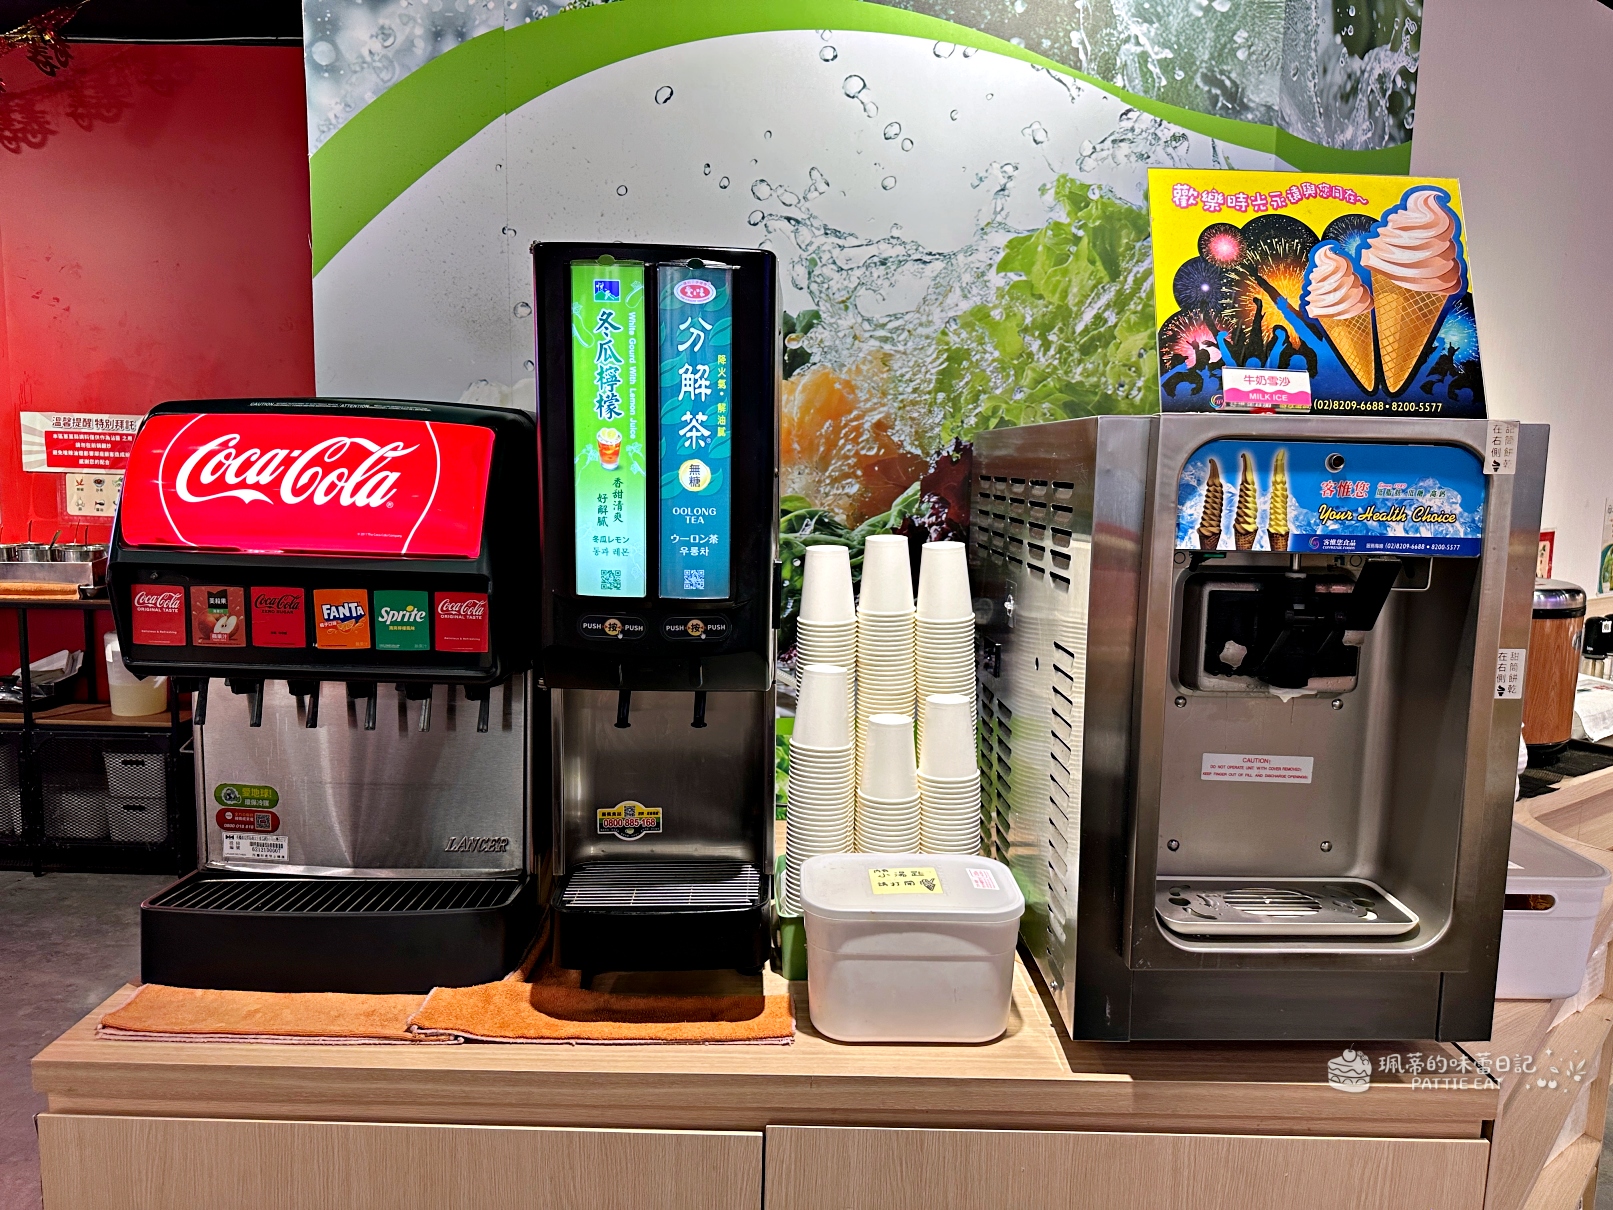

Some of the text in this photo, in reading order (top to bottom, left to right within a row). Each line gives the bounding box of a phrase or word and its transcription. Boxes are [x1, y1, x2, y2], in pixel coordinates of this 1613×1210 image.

[595, 311, 622, 419] 冬瓜檸檬
[628, 312, 637, 440] White Gourd With Lemon Juice
[677, 317, 713, 449] 分解茶
[1243, 374, 1290, 387] 牛奶雪沙
[1249, 393, 1288, 402] MILK ICE
[1313, 398, 1384, 411] (02)8209-6688
[1391, 402, 1442, 412] 8200-5577
[52, 416, 136, 432] 溫馨提醒 特別拜託
[1491, 425, 1502, 457] 在右側
[176, 433, 420, 508] Coca-Cola
[689, 464, 701, 487] 無糖
[612, 477, 624, 523] 香甜清爽
[597, 493, 609, 527] 好解膩
[672, 507, 717, 516] OOLONG
[1319, 505, 1456, 524] Your Health Choice
[685, 516, 705, 524] TEA
[592, 535, 630, 544] 冬瓜レモン
[671, 534, 719, 544] ウーロン茶
[612, 547, 630, 557] 레몬
[679, 547, 709, 556] 우롱차
[135, 592, 183, 609] Coca-Cola
[254, 594, 301, 610] Coca-Cola
[438, 598, 487, 616] Coca-Cola
[322, 601, 364, 620] FANTA
[378, 605, 426, 624] Sprite
[608, 622, 618, 632] 按
[690, 623, 700, 632] 按
[1496, 652, 1507, 684] 在右側
[445, 836, 509, 853] LANCER
